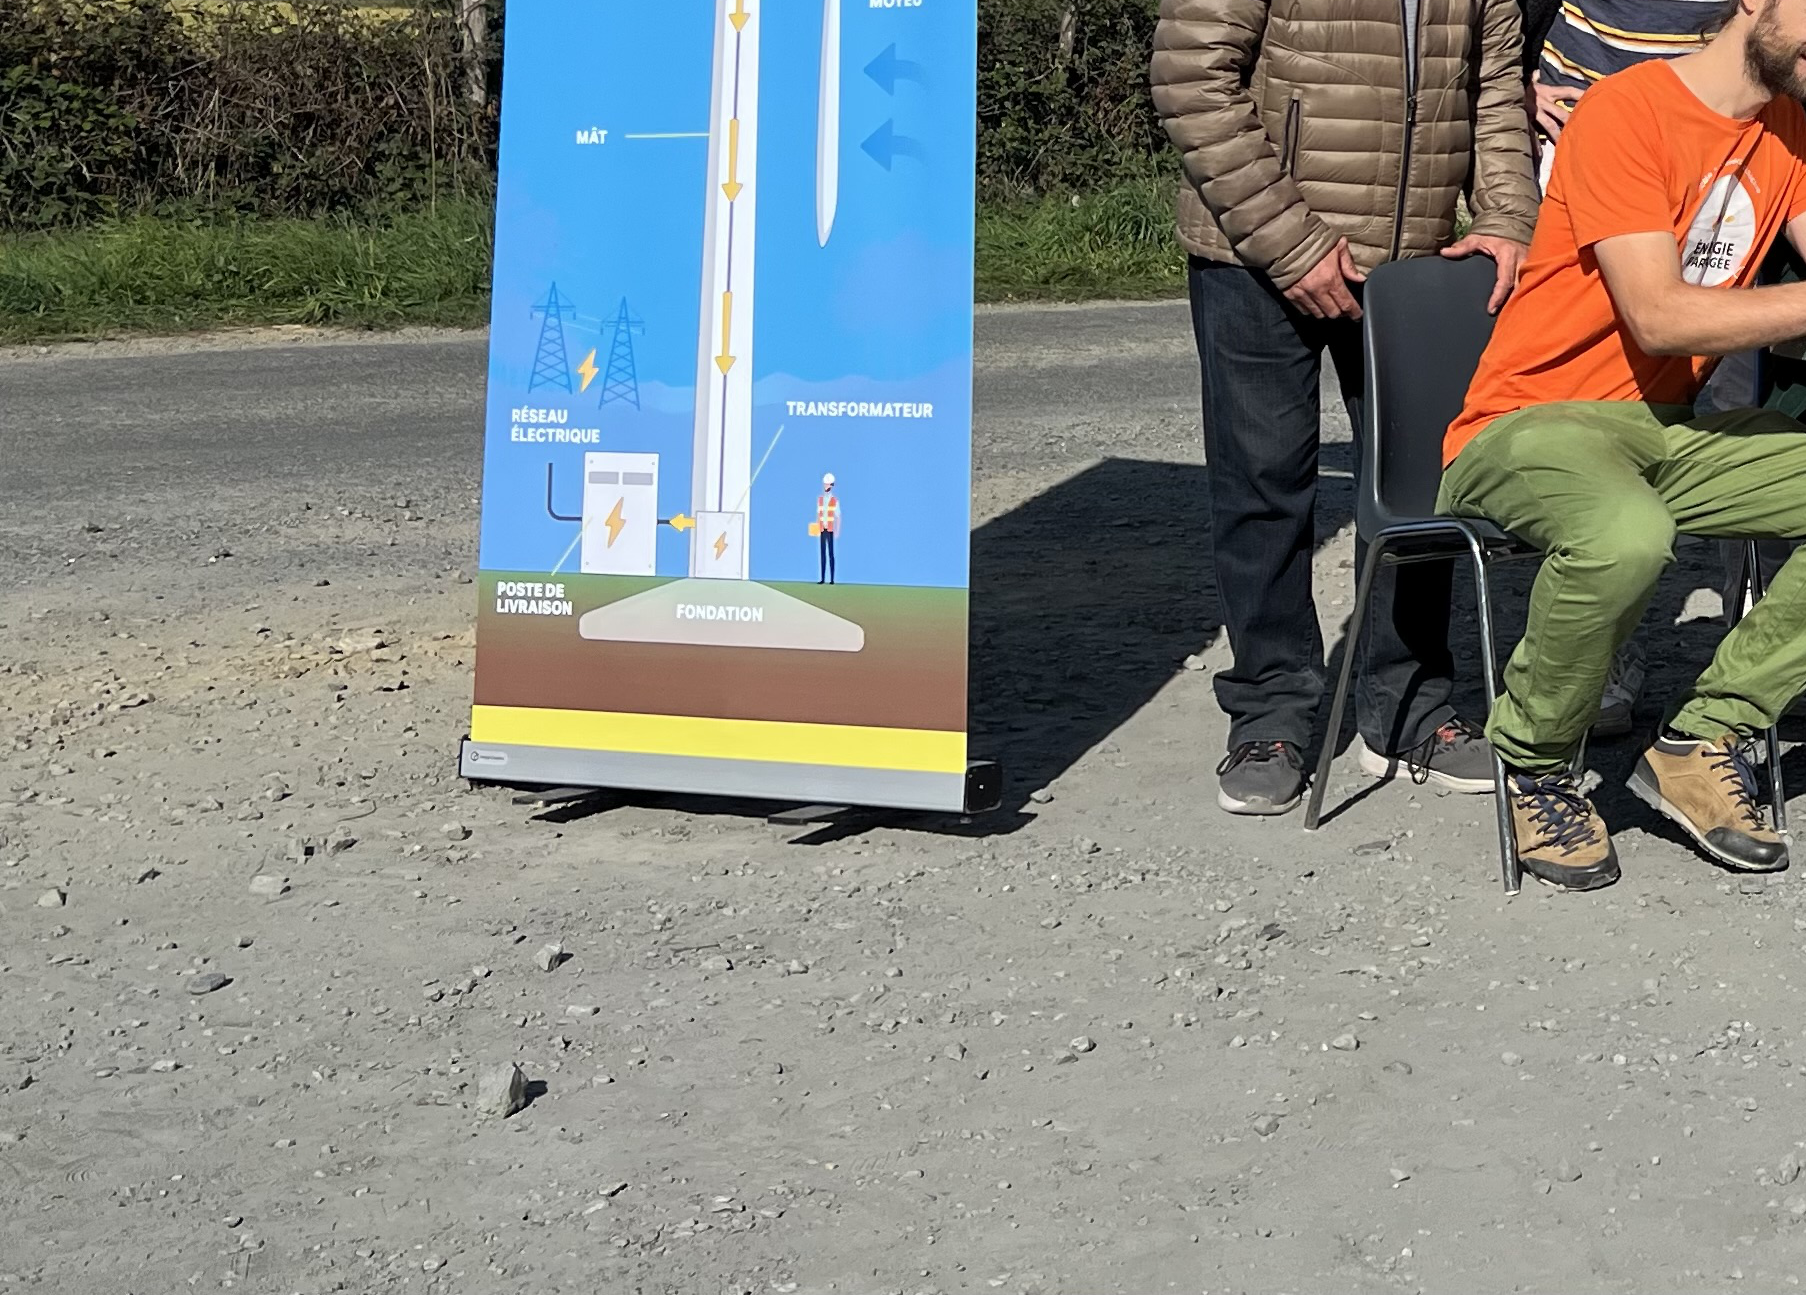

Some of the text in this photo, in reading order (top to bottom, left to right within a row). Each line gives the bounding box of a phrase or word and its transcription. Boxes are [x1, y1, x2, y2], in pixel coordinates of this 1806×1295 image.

[576, 126, 608, 145] MÂT
[511, 405, 568, 424] RÉSEAU
[786, 401, 933, 418] TRANSFORMATEUR
[511, 424, 601, 444] ÉLECTRIQUE
[497, 581, 565, 599] POSTE DE
[496, 598, 573, 616] LIVRAISON
[676, 604, 764, 622] FONDATION
